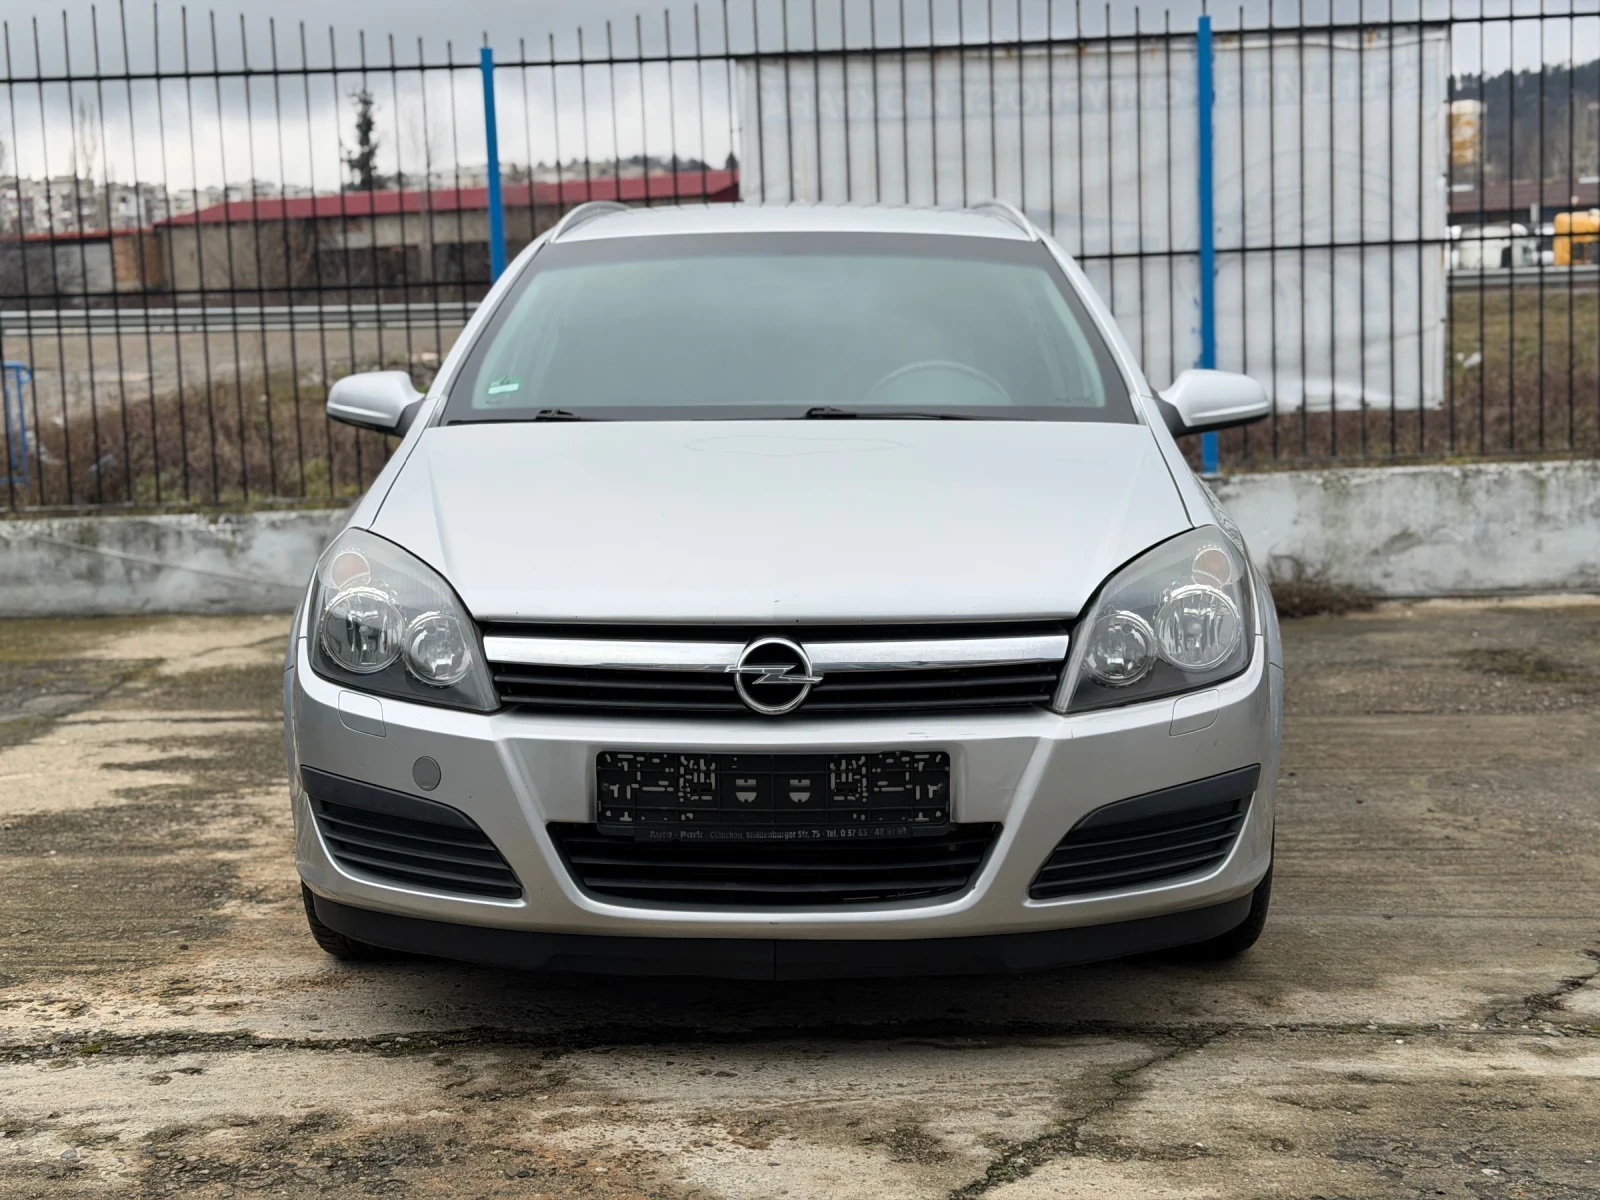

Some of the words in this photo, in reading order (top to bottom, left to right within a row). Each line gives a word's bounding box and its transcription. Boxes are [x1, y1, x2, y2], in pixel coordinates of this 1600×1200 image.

[680, 830, 704, 839] Park
[797, 829, 810, 839] Str.
[811, 829, 821, 838] 75
[826, 828, 839, 838] Tel.
[847, 828, 856, 837] 37
